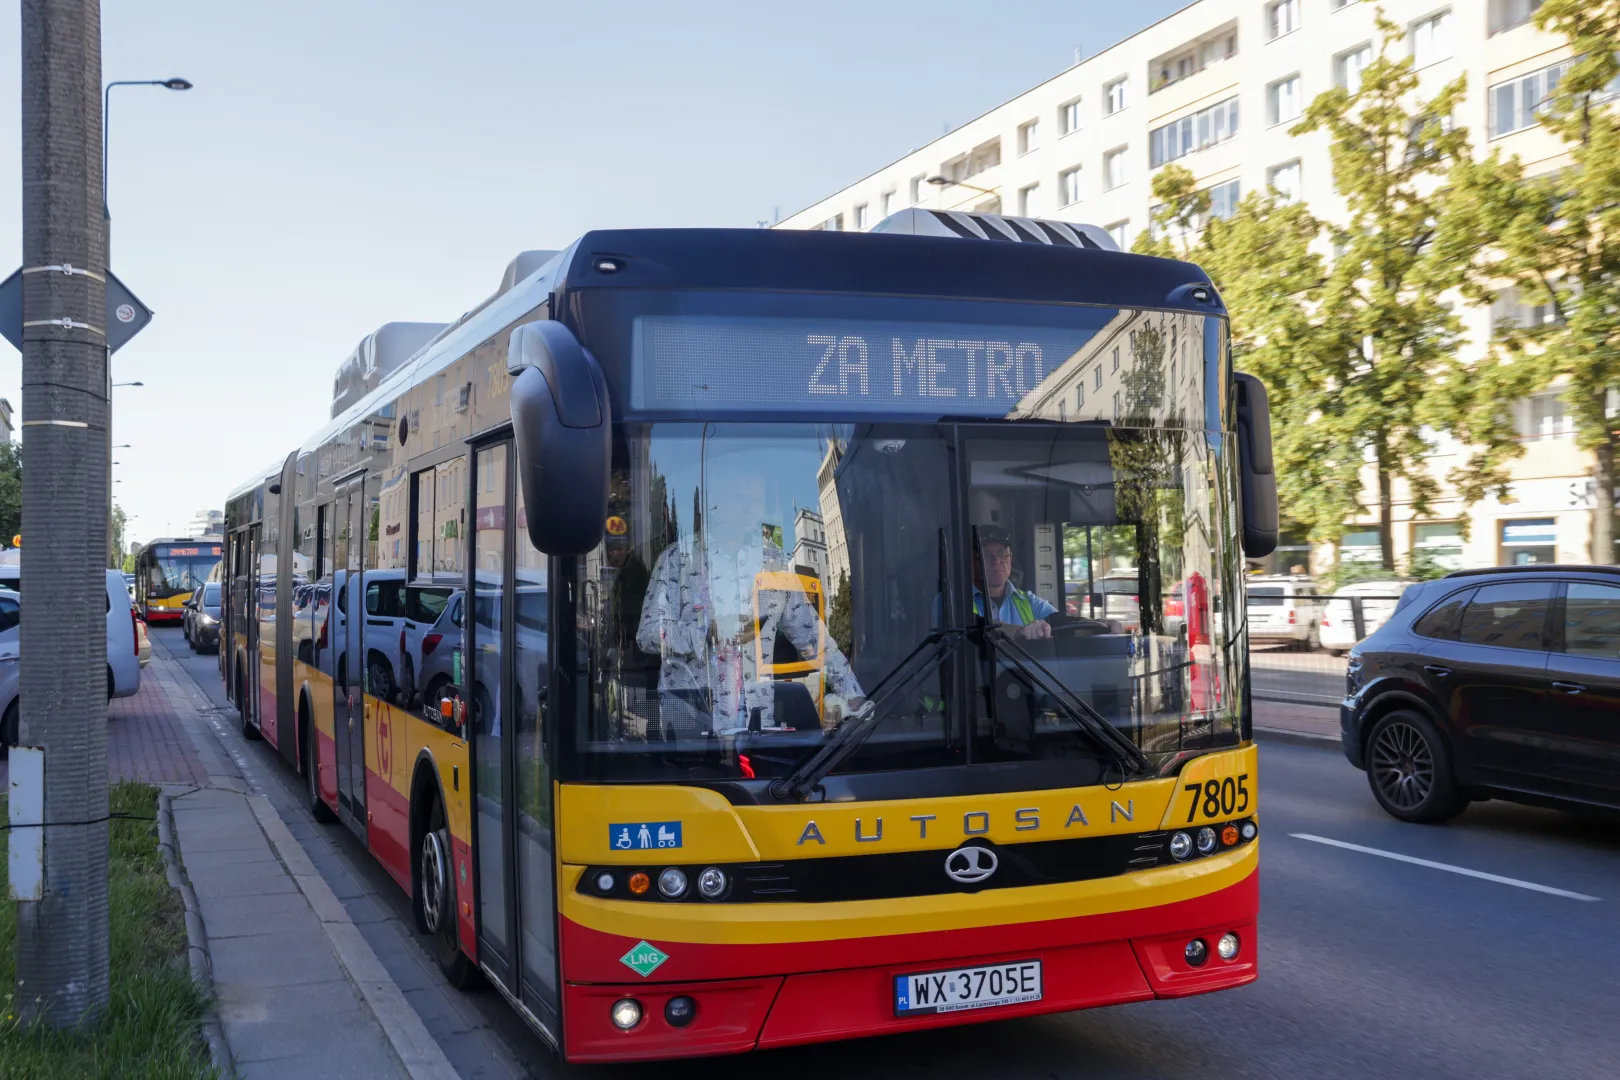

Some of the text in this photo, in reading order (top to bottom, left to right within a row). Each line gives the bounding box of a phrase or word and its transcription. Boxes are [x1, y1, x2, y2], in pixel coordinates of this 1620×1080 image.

[807, 334, 1044, 398] ZA METRO
[1184, 773, 1249, 823] 7805
[796, 799, 1134, 846] AUTOSAN
[630, 952, 659, 965] LNG
[898, 996, 908, 1005] PL
[914, 965, 1035, 1005] WX 3705E
